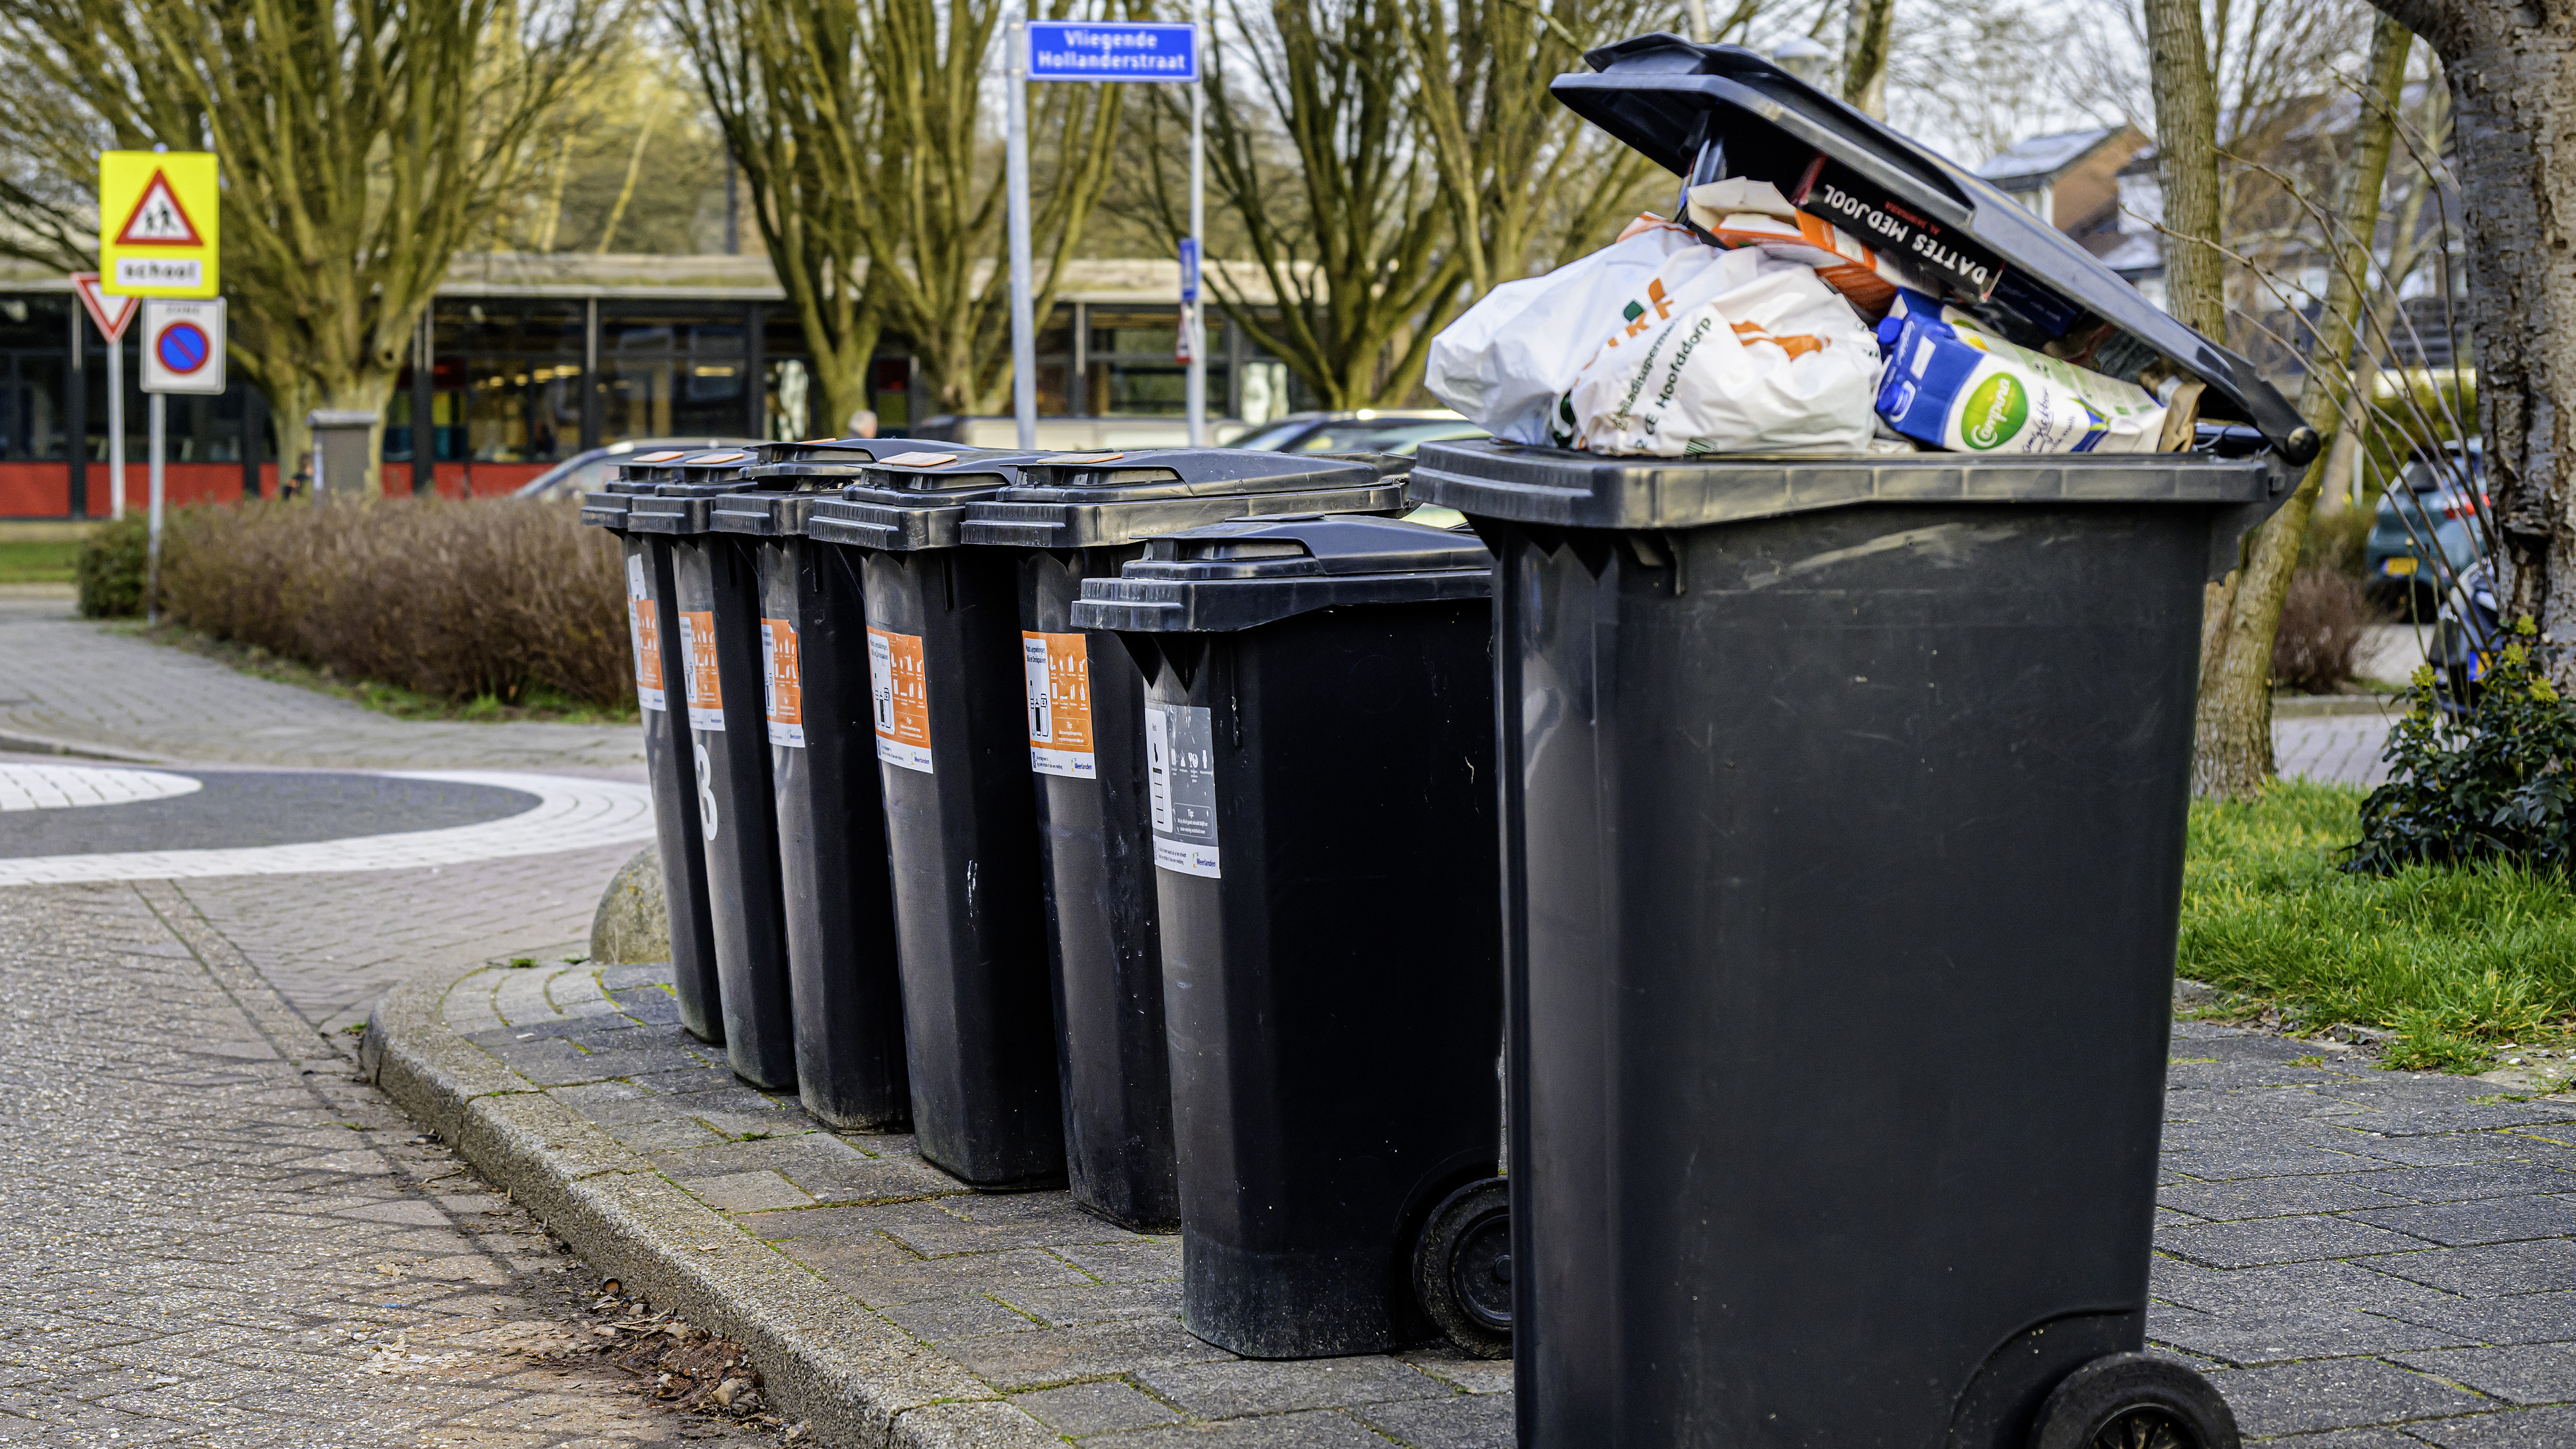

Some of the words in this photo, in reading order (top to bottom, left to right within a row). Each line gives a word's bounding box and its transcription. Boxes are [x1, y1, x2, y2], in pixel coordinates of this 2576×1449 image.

[1038, 50, 1186, 70] Hollanderstraat
[1064, 30, 1158, 54] Vliegende
[1823, 184, 1910, 243] MEDJOOL
[124, 260, 196, 278] school
[1911, 234, 1988, 284] DATTES
[1655, 317, 1711, 409] Hoofddorp
[1970, 378, 2010, 447] Campina
[1074, 762, 1093, 770] Meerlanden
[696, 743, 718, 841] 3
[1196, 857, 1216, 867] Meerlanden
